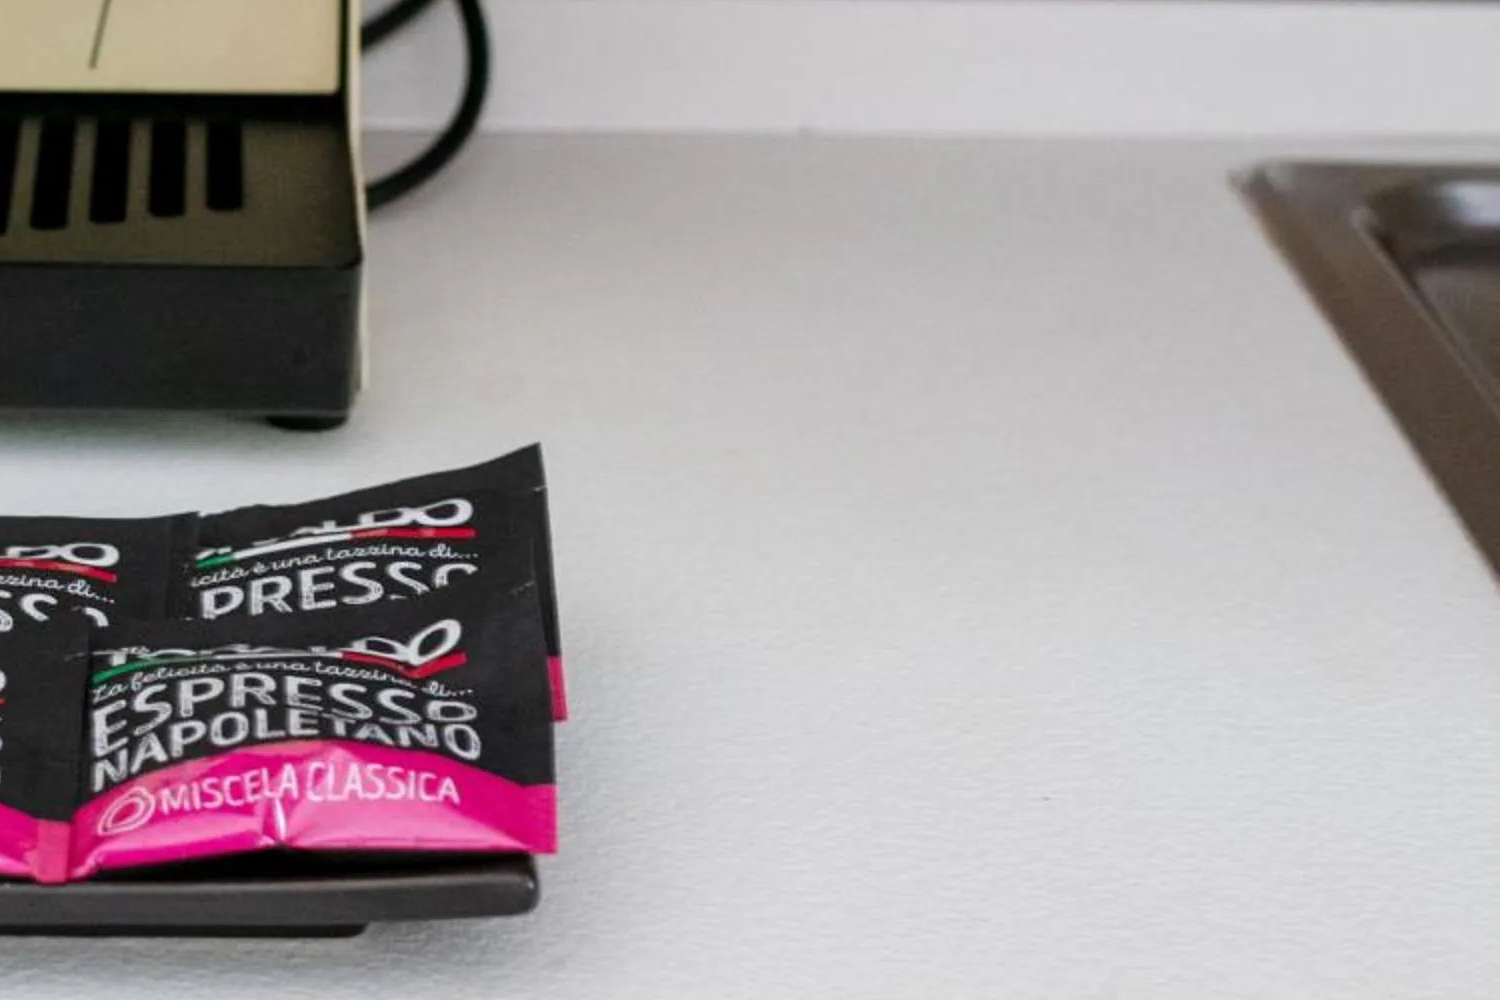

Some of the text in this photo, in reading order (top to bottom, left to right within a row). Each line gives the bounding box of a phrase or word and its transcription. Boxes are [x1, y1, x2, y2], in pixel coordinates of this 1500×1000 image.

[88, 672, 478, 756] ESPRESSO
[91, 710, 482, 792] NAPOLETANO
[161, 763, 461, 816] MISCELA CLASSICA
